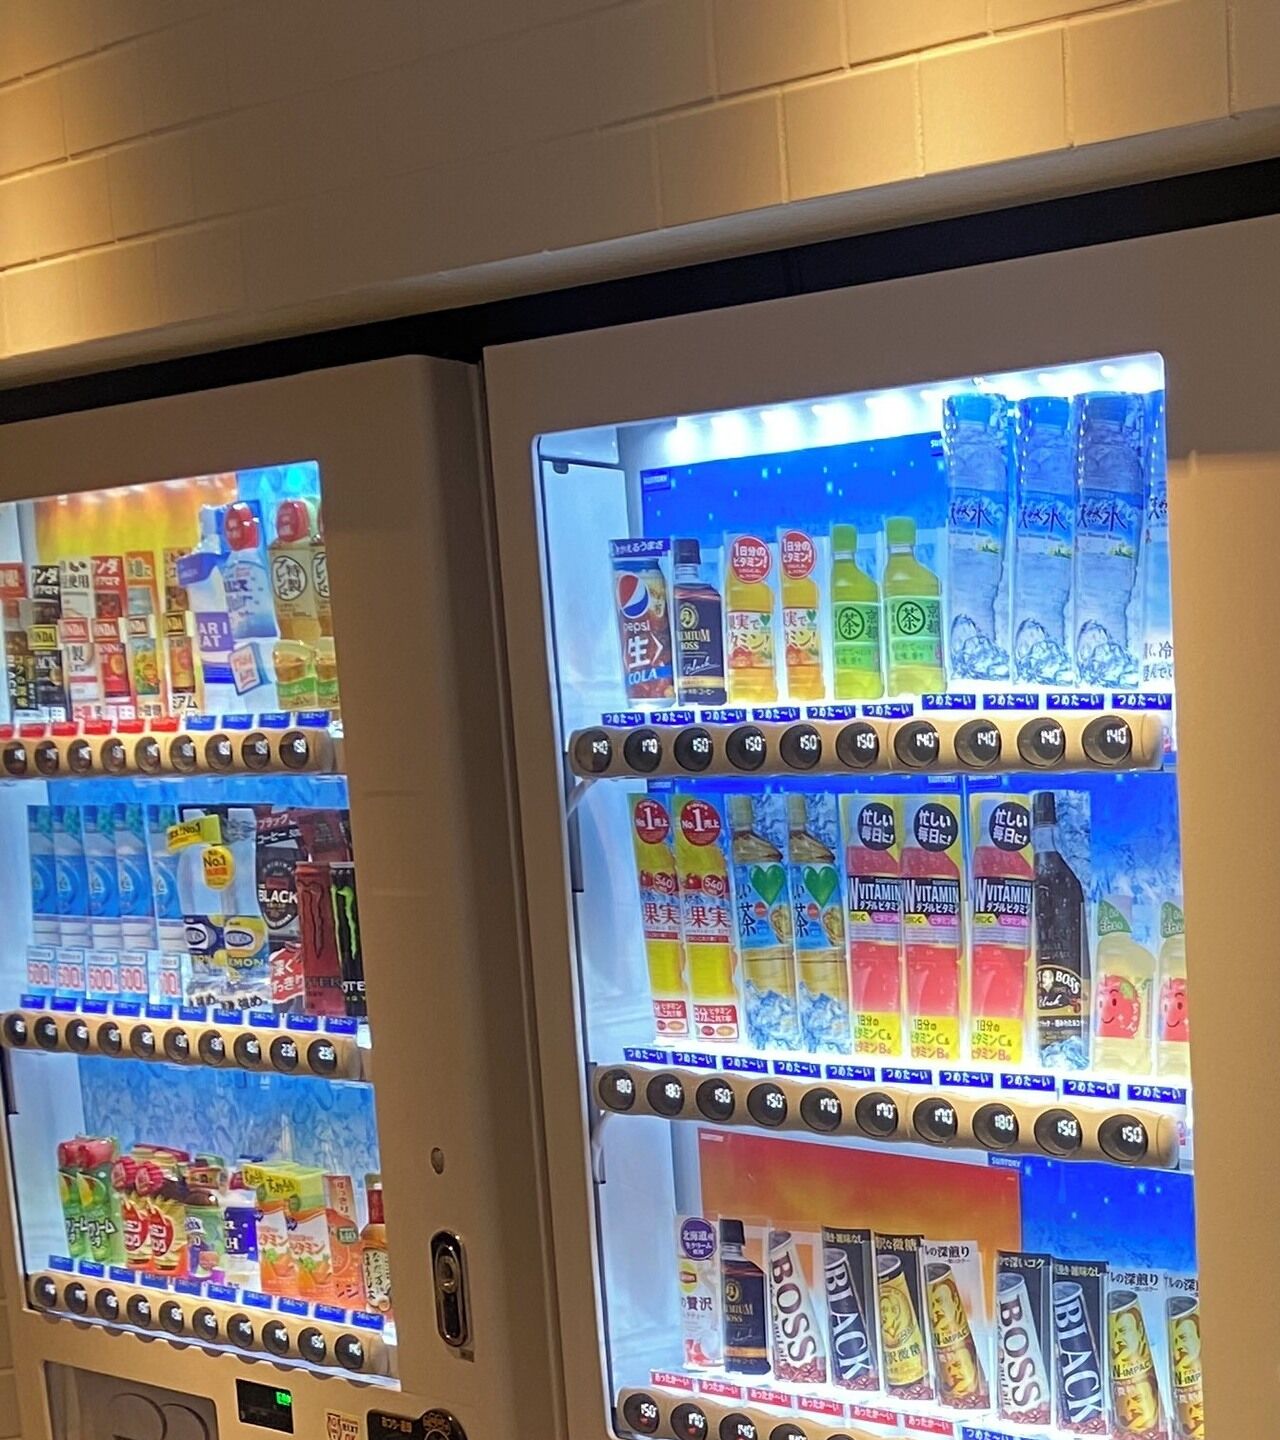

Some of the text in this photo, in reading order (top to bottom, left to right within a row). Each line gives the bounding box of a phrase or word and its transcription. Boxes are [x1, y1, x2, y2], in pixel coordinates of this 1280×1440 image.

[734, 543, 766, 556] 1日分の
[285, 564, 302, 592] 特製
[628, 670, 658, 684] COLA
[857, 735, 875, 749] 150
[1041, 730, 1061, 744] 140
[917, 809, 951, 827] 忙しい
[995, 809, 1029, 827] 忙しい
[259, 890, 297, 904] BLACK
[1055, 971, 1081, 994] BOSS
[772, 1251, 873, 1380] BOSS BLACK
[1000, 1295, 1104, 1422] BOSS BLACK
